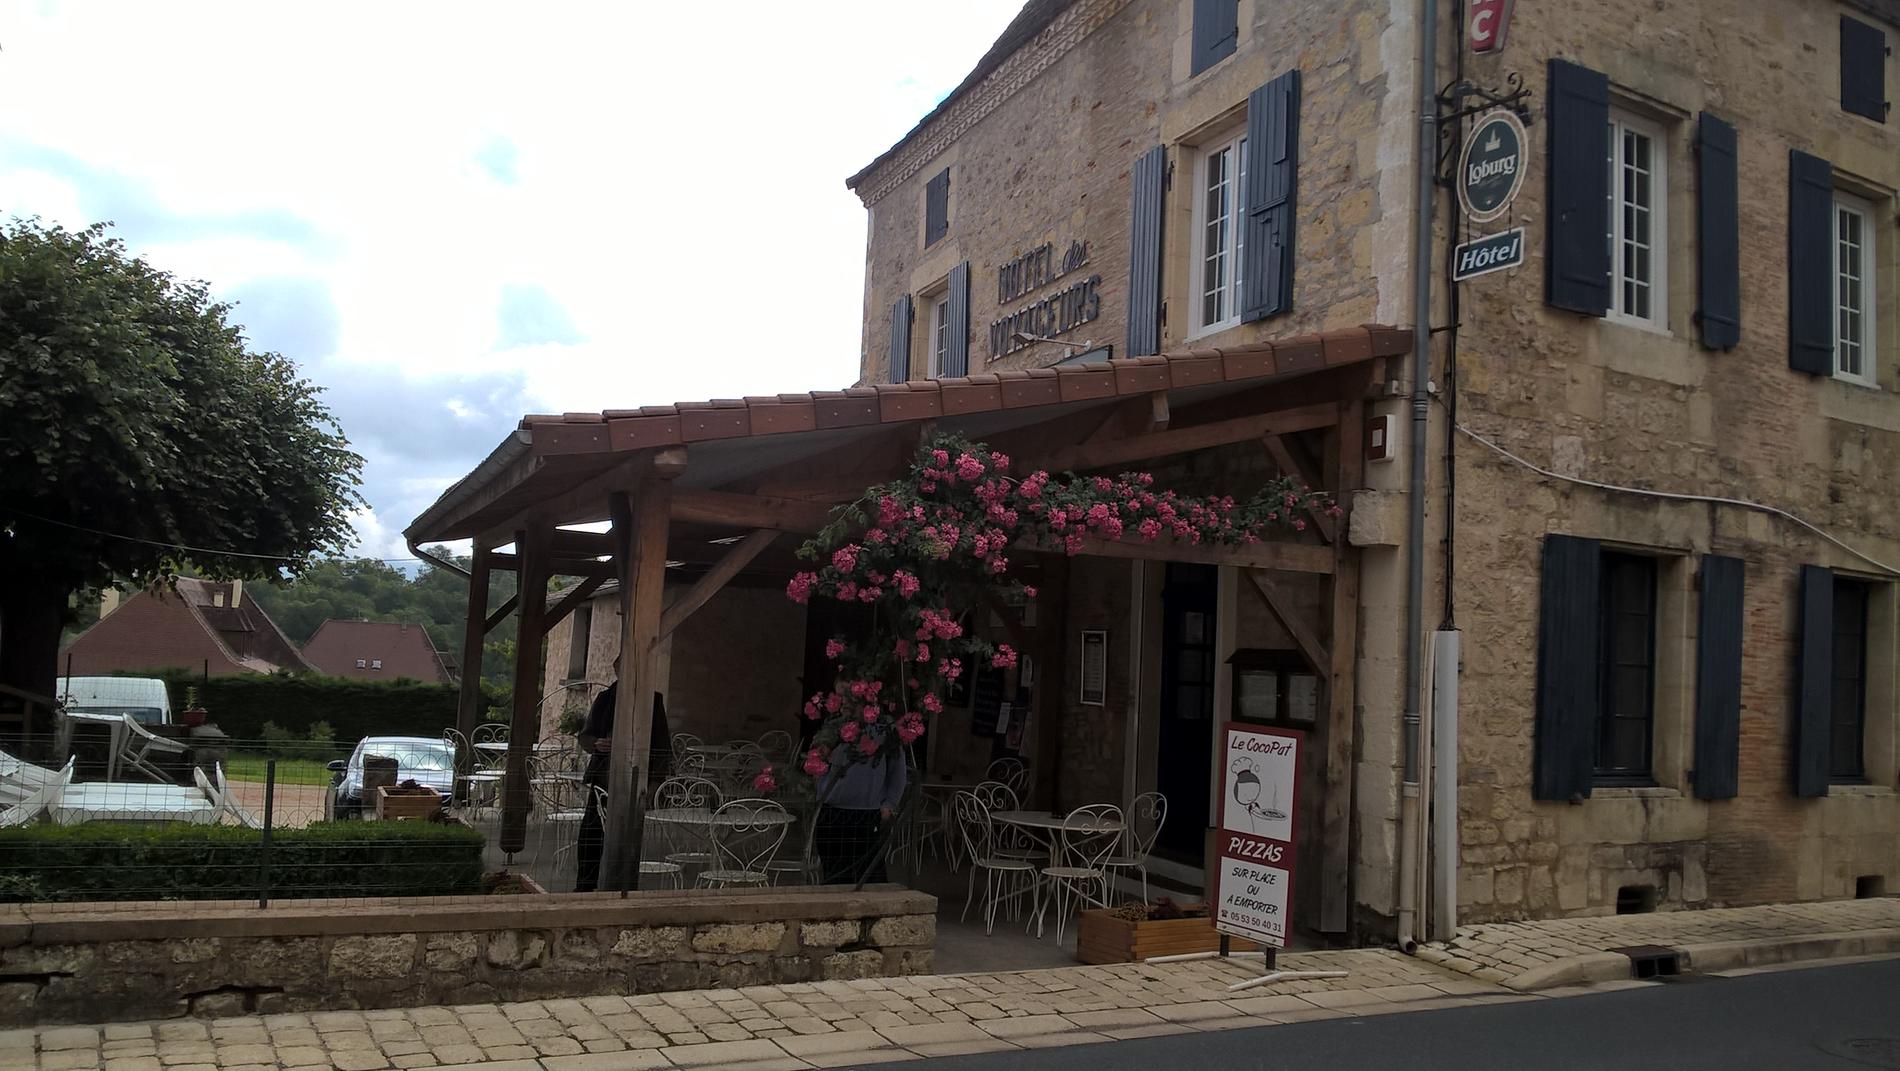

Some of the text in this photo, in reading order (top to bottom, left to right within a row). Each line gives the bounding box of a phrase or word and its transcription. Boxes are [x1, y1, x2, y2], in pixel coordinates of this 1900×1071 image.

[1468, 154, 1516, 186] Loburg
[1459, 238, 1520, 272] Hôtel
[998, 241, 1055, 304] HOTEL
[990, 274, 1101, 361] VOYAGEURS
[1231, 736, 1293, 757] Le CocoPat
[1228, 836, 1284, 863] PIZZAS
[1231, 867, 1277, 885] SUR PLACE
[1246, 885, 1260, 896] OU
[1226, 894, 1279, 915] A EMPORTER
[1230, 912, 1282, 932] 05 53 50 40 31
